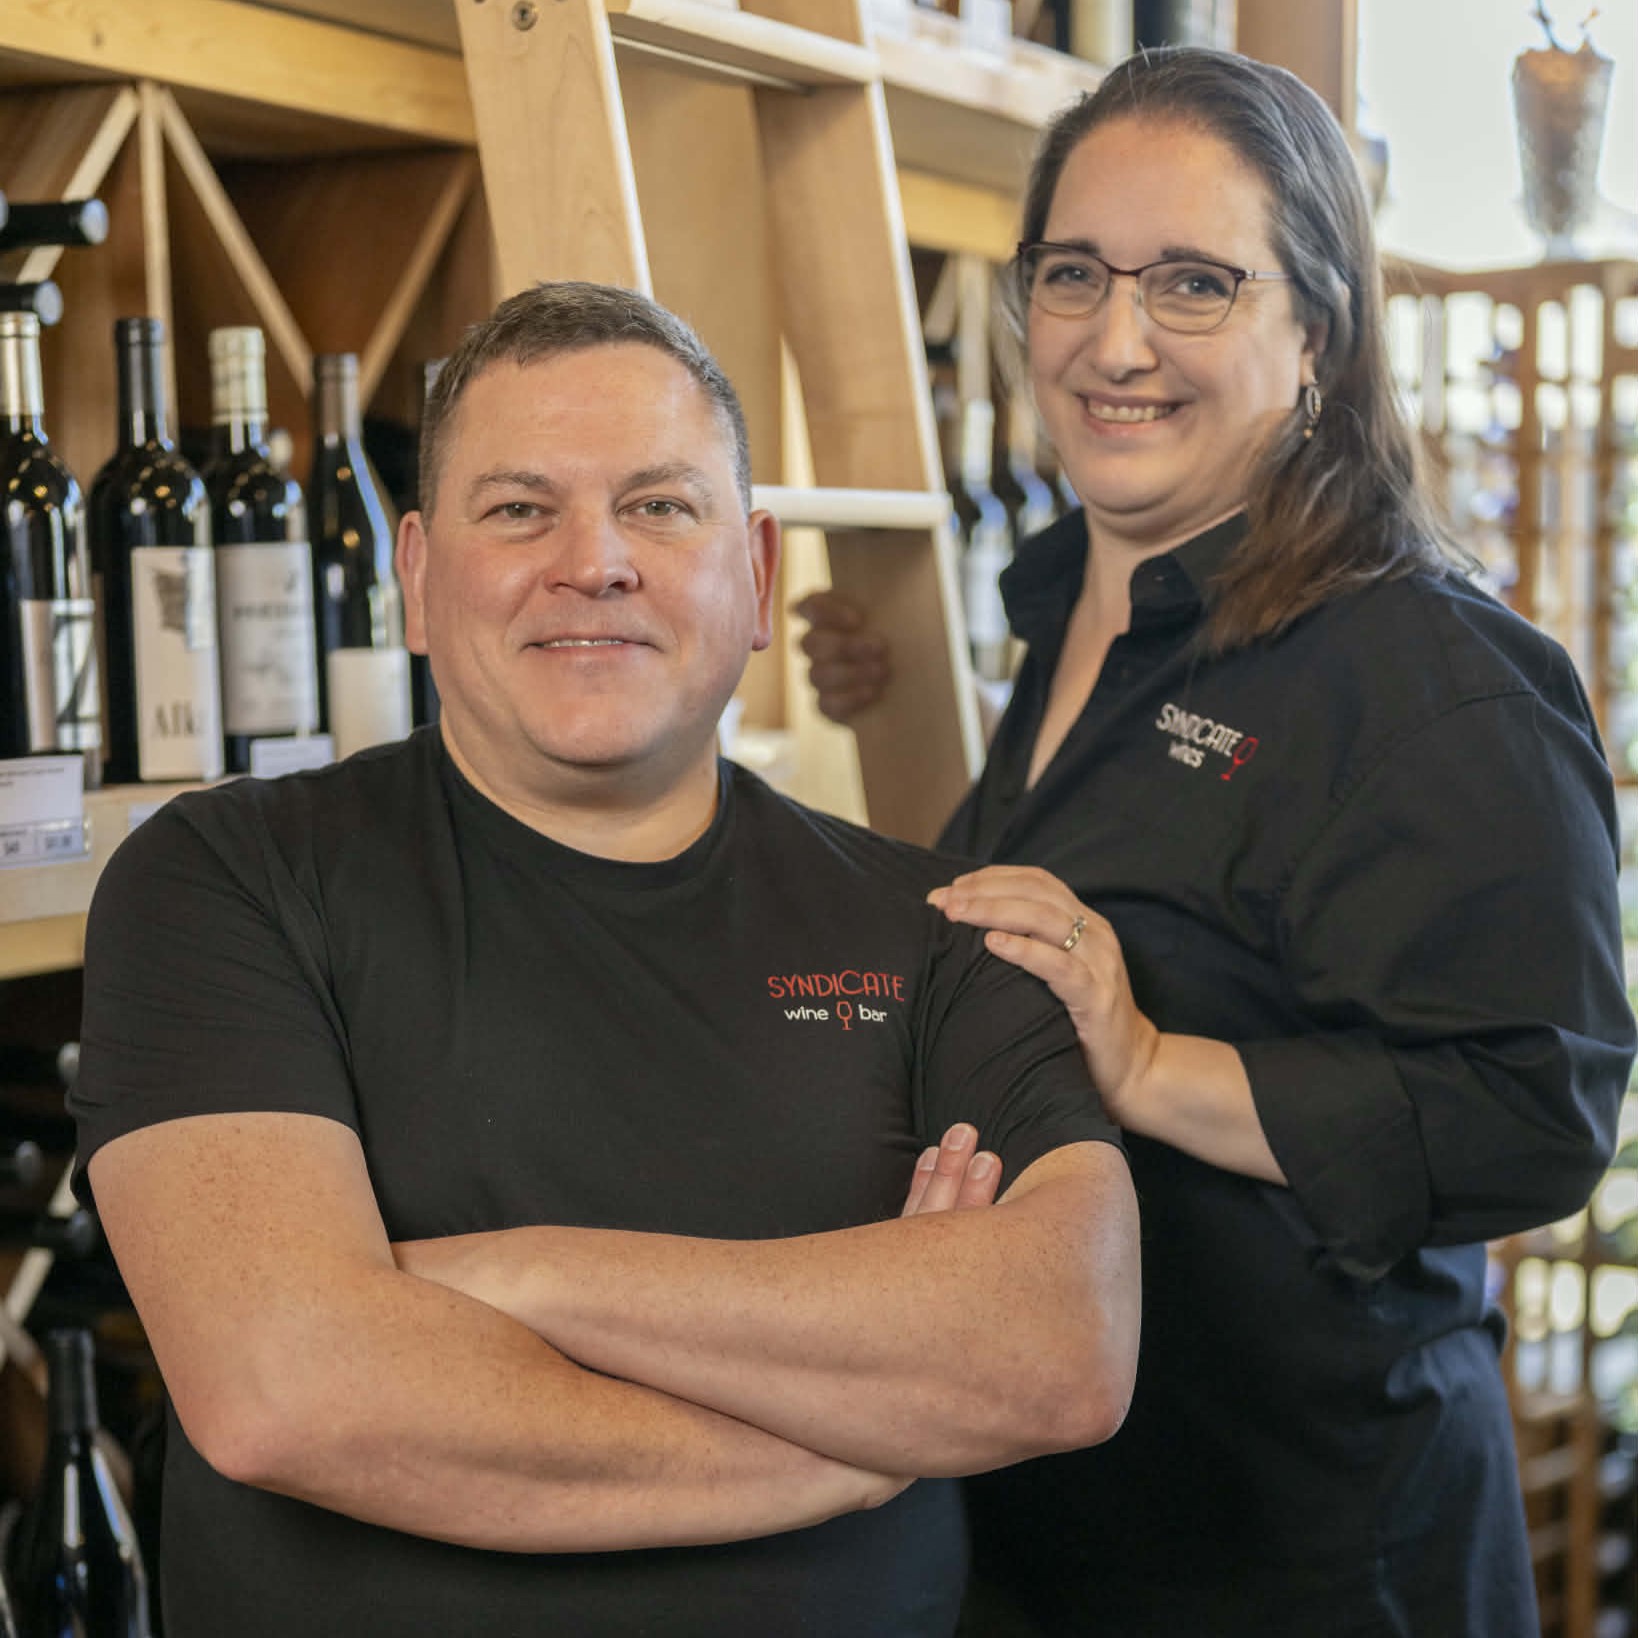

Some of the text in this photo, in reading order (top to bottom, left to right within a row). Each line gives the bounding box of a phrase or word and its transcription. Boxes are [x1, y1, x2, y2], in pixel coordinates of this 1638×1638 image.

[767, 970, 905, 1002] SYNDICATE
[784, 1004, 887, 1023] wine bar
